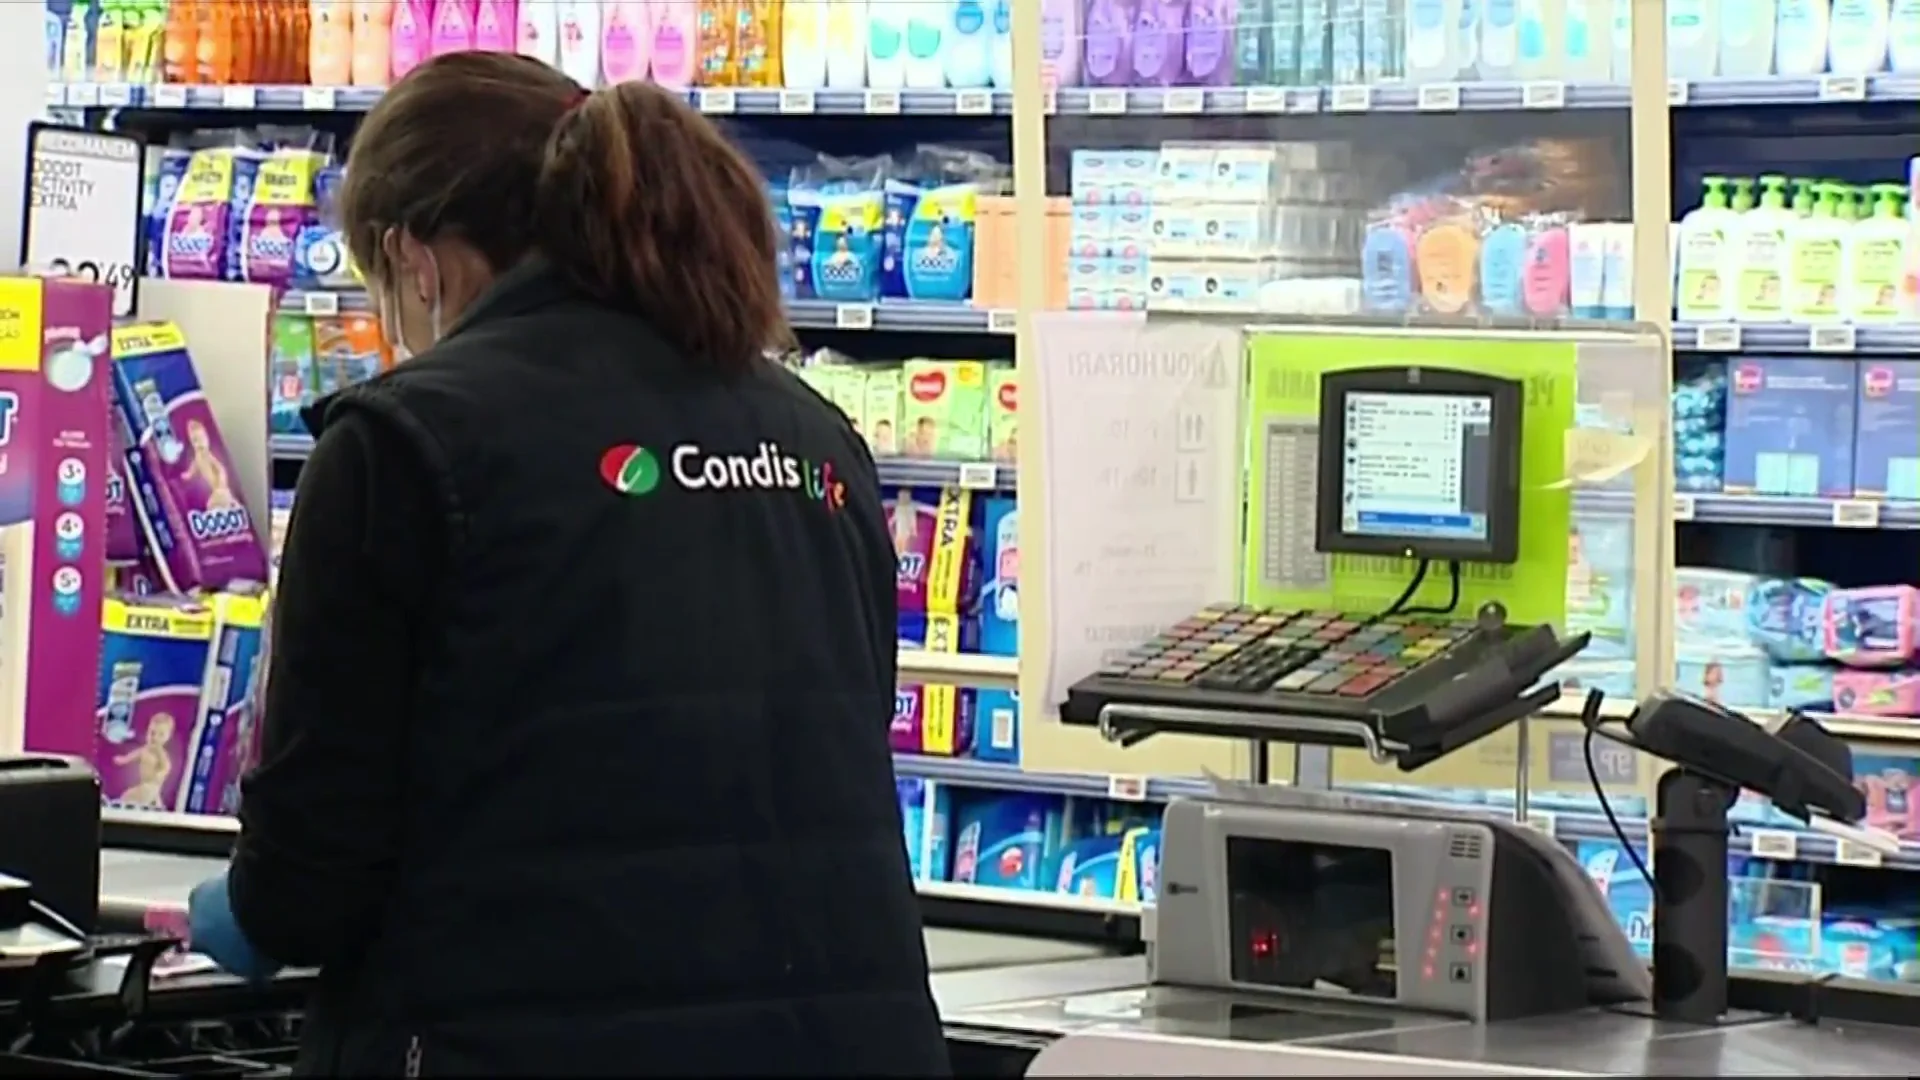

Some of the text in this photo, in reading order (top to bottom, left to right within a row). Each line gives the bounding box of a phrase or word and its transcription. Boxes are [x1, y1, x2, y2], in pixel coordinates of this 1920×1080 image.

[31, 190, 78, 211] EXTRA
[672, 441, 846, 514] Condis life
